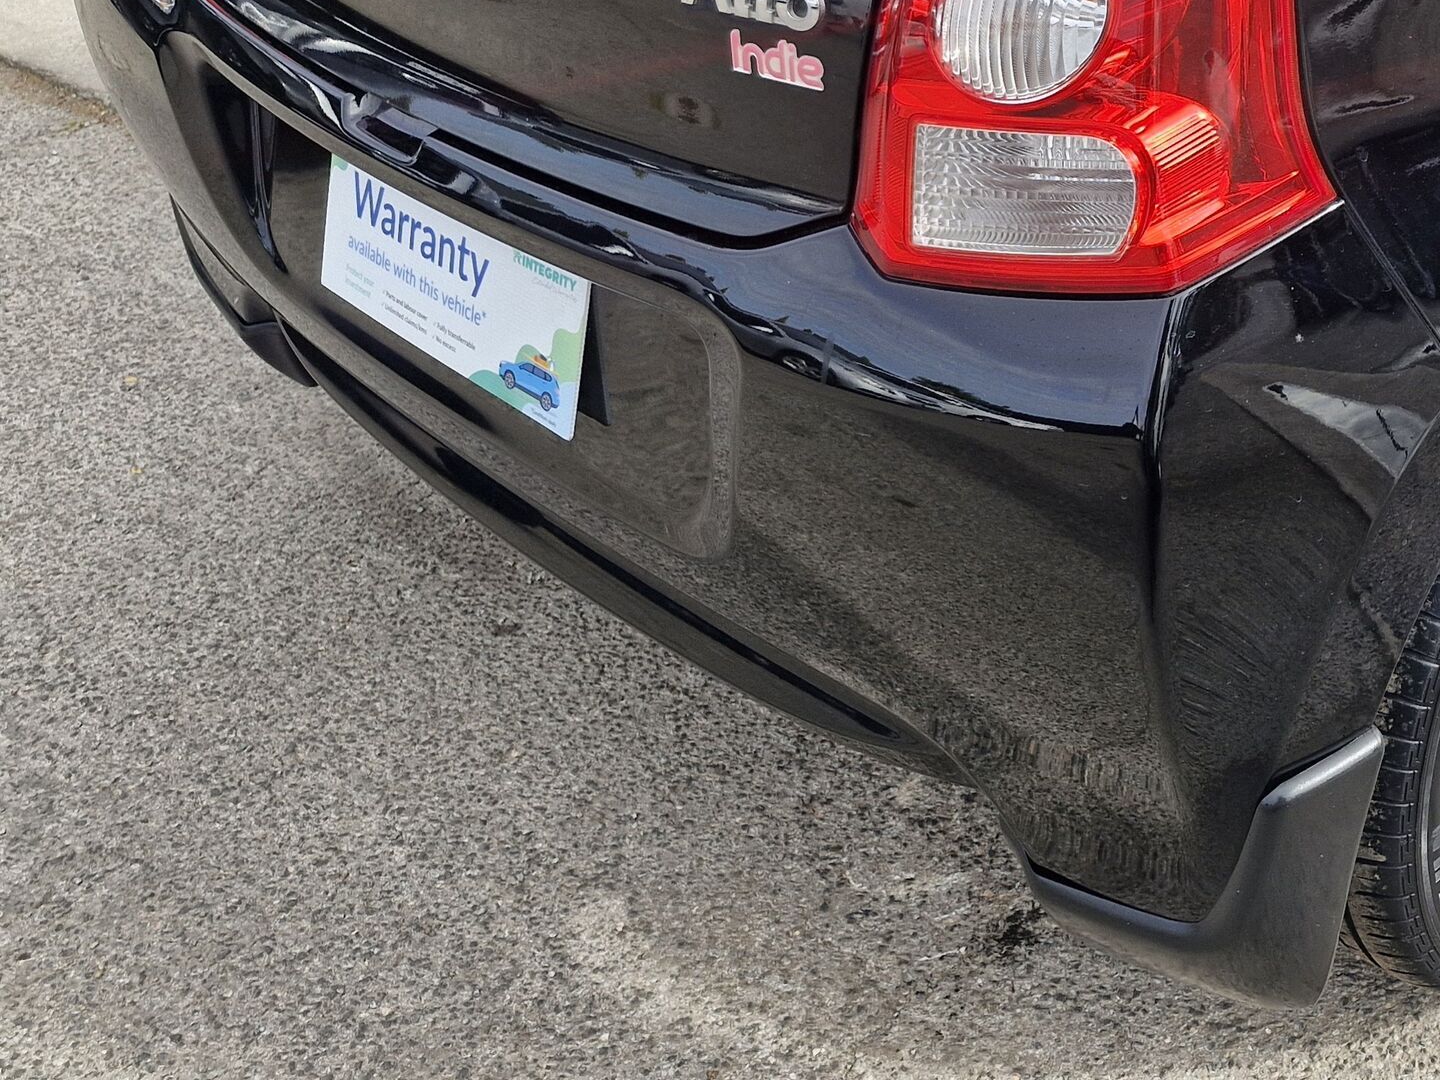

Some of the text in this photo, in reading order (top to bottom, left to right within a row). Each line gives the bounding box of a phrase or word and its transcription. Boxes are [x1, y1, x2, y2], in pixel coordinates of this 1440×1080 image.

[729, 28, 825, 91] Indie
[354, 170, 490, 298] Warranty
[347, 235, 391, 271] available
[393, 263, 416, 289] with
[419, 275, 440, 301] this
[522, 254, 577, 292] INTEGRITY
